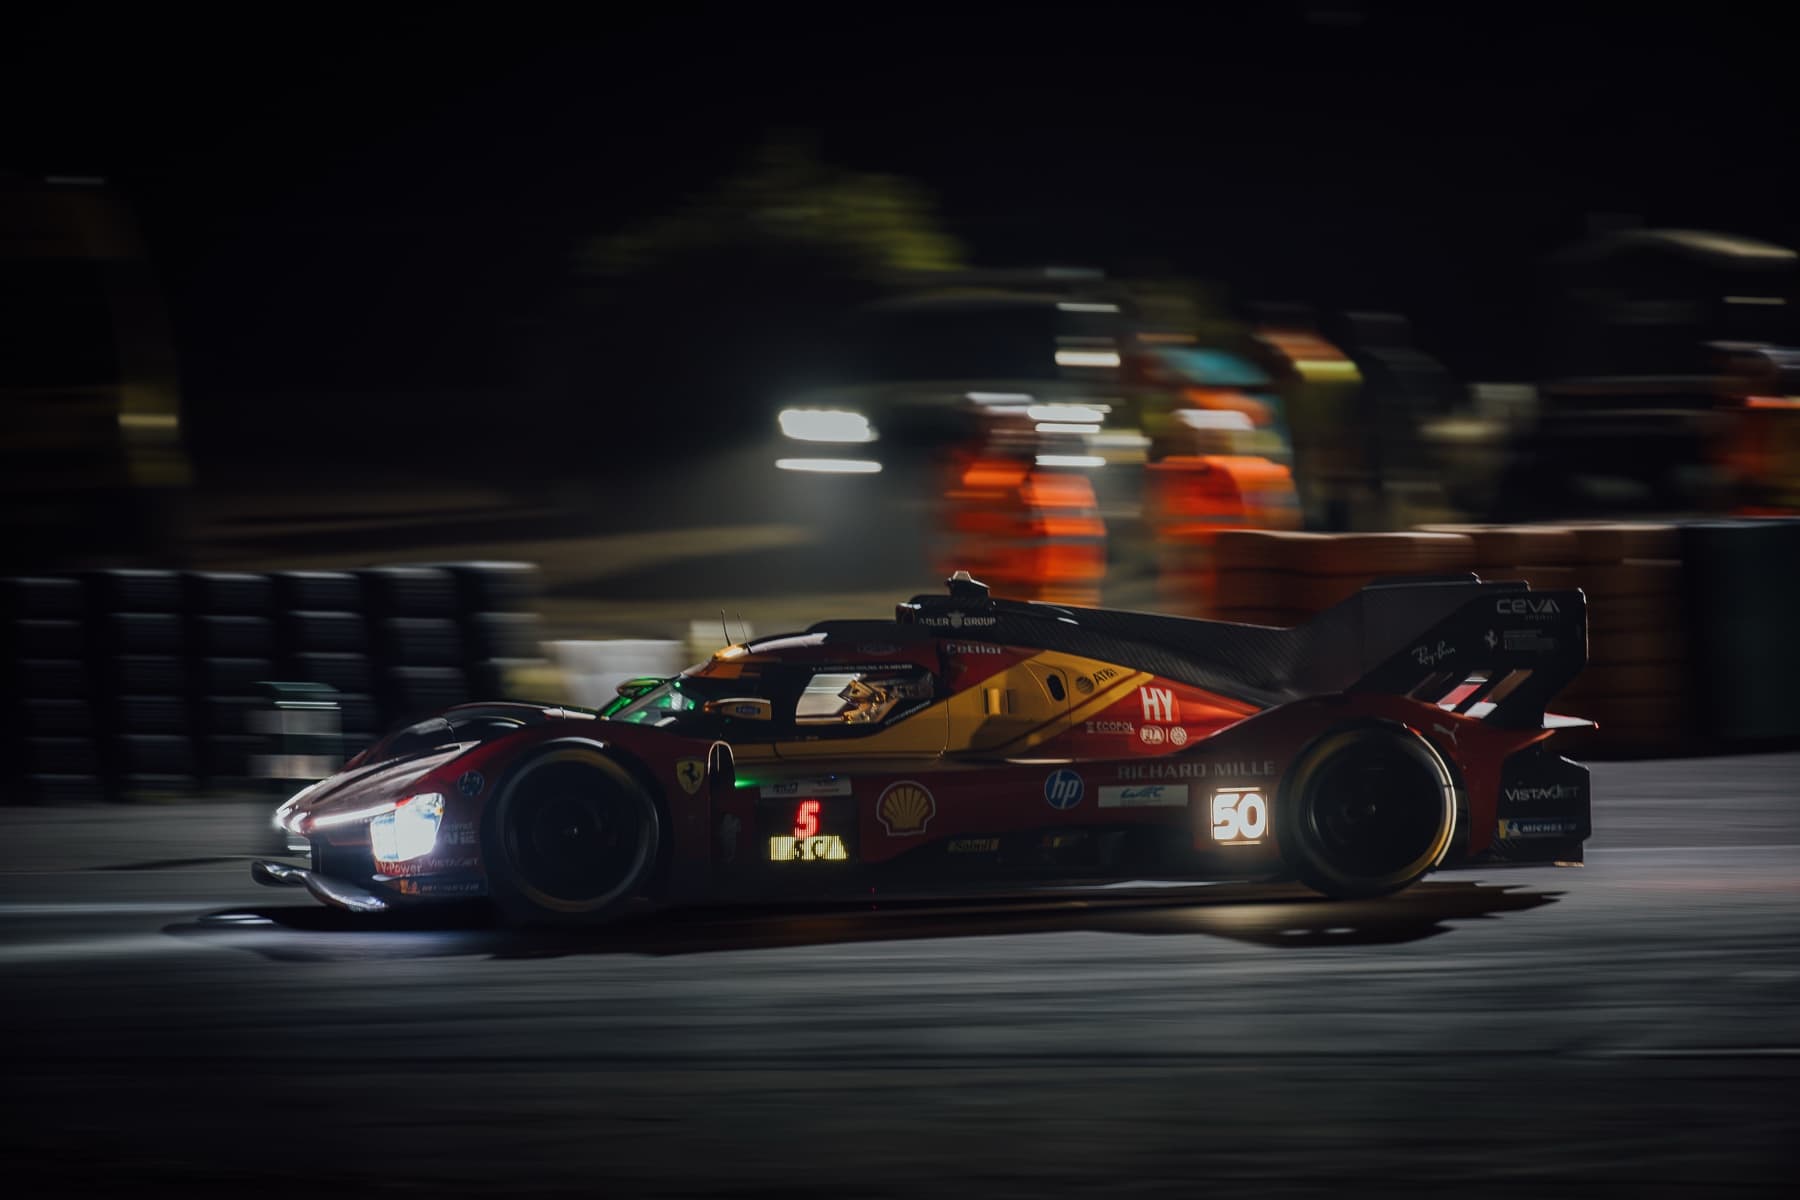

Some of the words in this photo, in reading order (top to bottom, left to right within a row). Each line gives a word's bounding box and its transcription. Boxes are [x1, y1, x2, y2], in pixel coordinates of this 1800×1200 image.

[919, 616, 949, 627] ADLER
[963, 616, 997, 627] GROUP
[1139, 686, 1174, 722] HY
[1118, 763, 1207, 779] RICHARD
[1213, 760, 1276, 777] MILLE
[1050, 769, 1080, 810] hp
[794, 800, 821, 840] 5
[1212, 792, 1267, 841] 50
